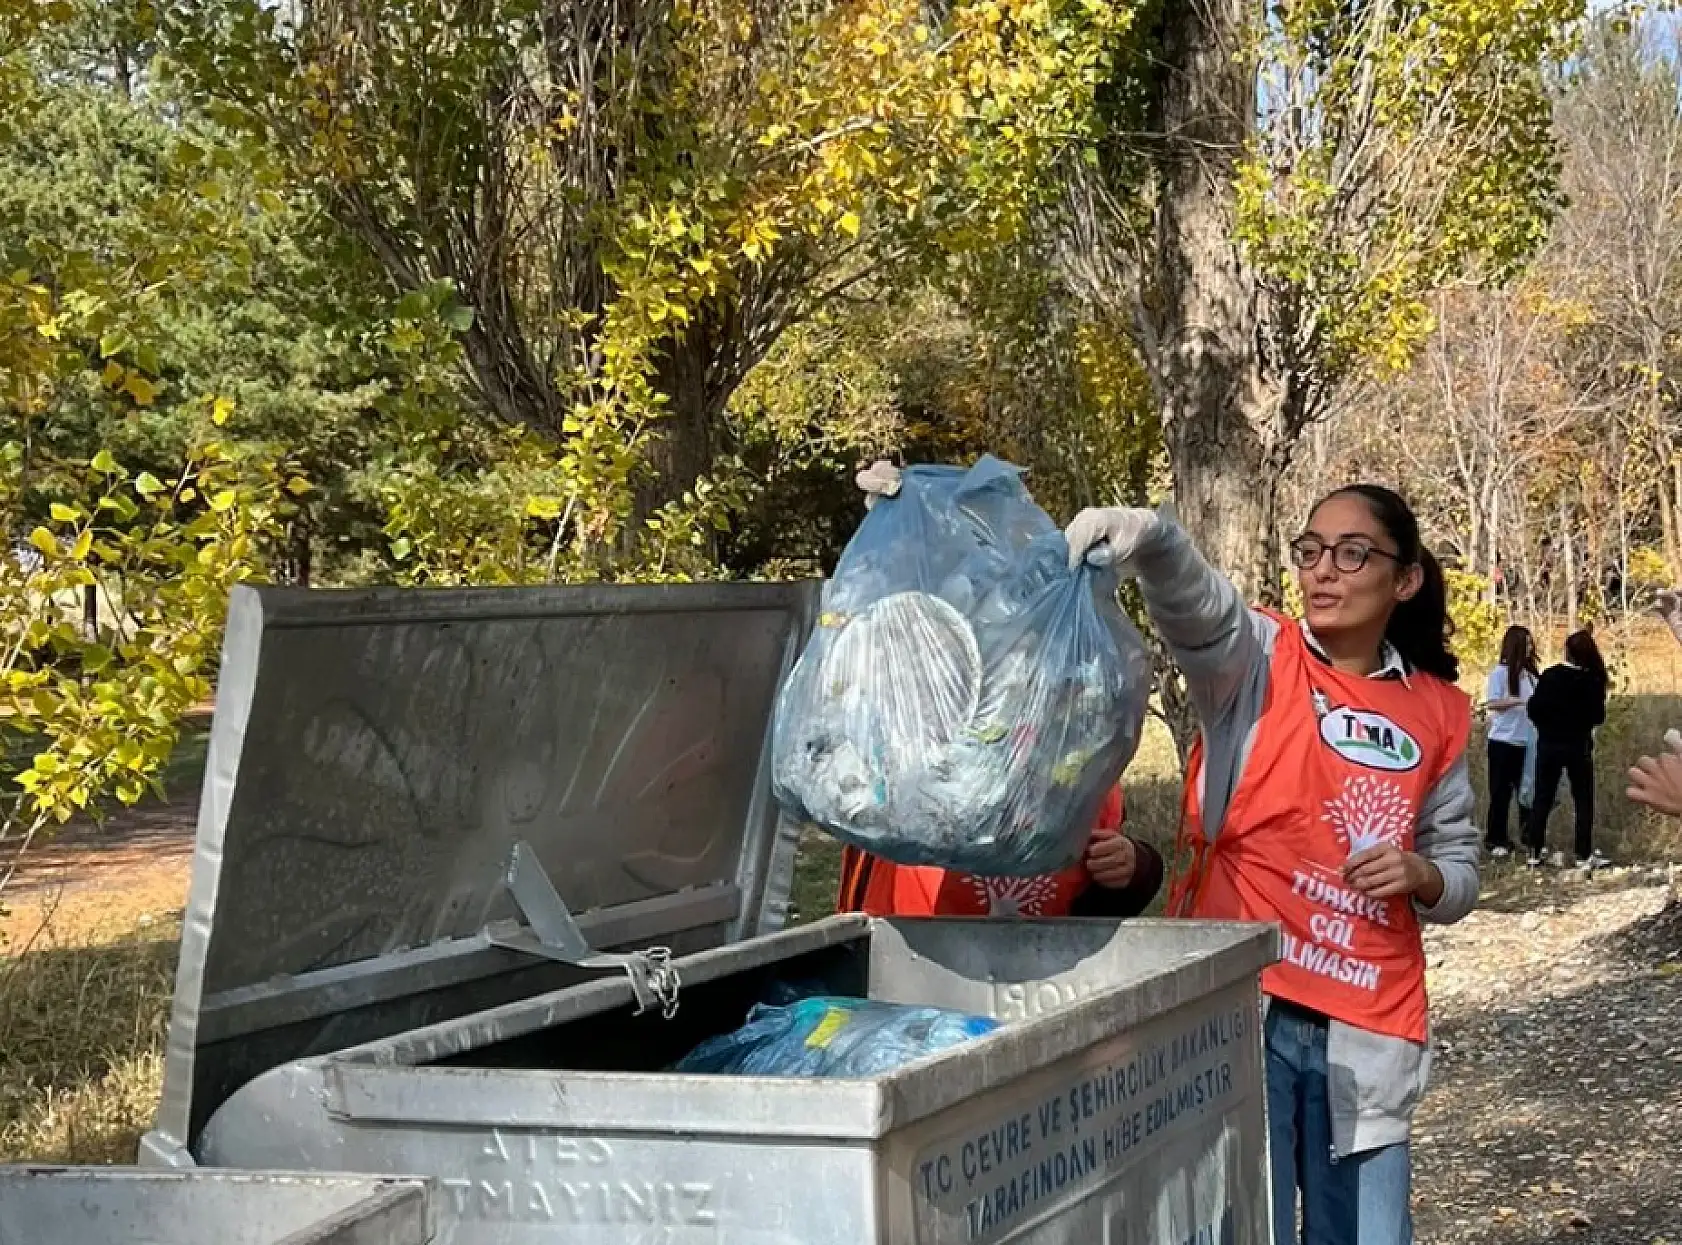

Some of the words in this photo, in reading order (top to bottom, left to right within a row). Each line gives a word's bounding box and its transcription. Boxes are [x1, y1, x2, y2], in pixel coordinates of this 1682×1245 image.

[1310, 912, 1356, 950] ÇÖL
[961, 1112, 1032, 1187] ÇEVRE
[1038, 1095, 1061, 1140] VE
[1070, 1044, 1166, 1134] ŞEHİRCİLİK
[966, 1136, 1097, 1241] TARAFINDAN
[1102, 1111, 1142, 1161] HİBE
[1146, 1061, 1232, 1137] EDİLMİŞTİR
[443, 1178, 716, 1222] TMAYINIZ
